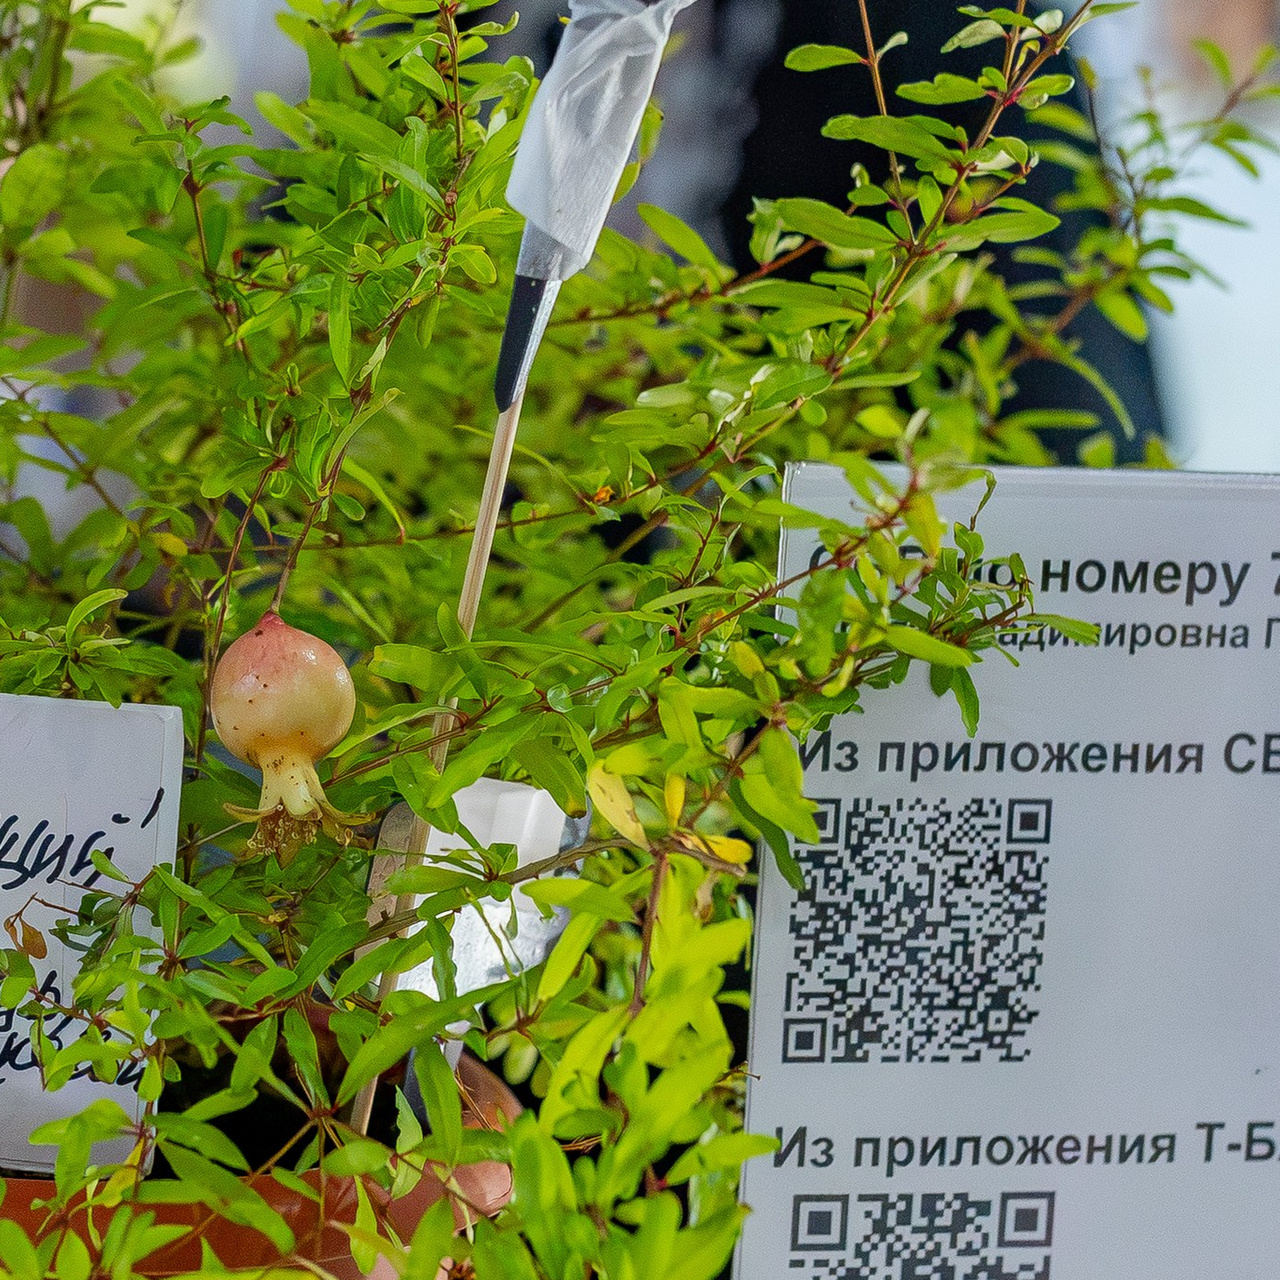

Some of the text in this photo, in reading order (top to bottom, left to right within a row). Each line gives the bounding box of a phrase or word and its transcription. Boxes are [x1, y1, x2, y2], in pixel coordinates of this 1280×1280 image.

[1041, 557, 1251, 608] номеру
[799, 731, 859, 773] Из
[878, 740, 1203, 782] приложения
[773, 1121, 1280, 1178] Из приложения Т-Б
